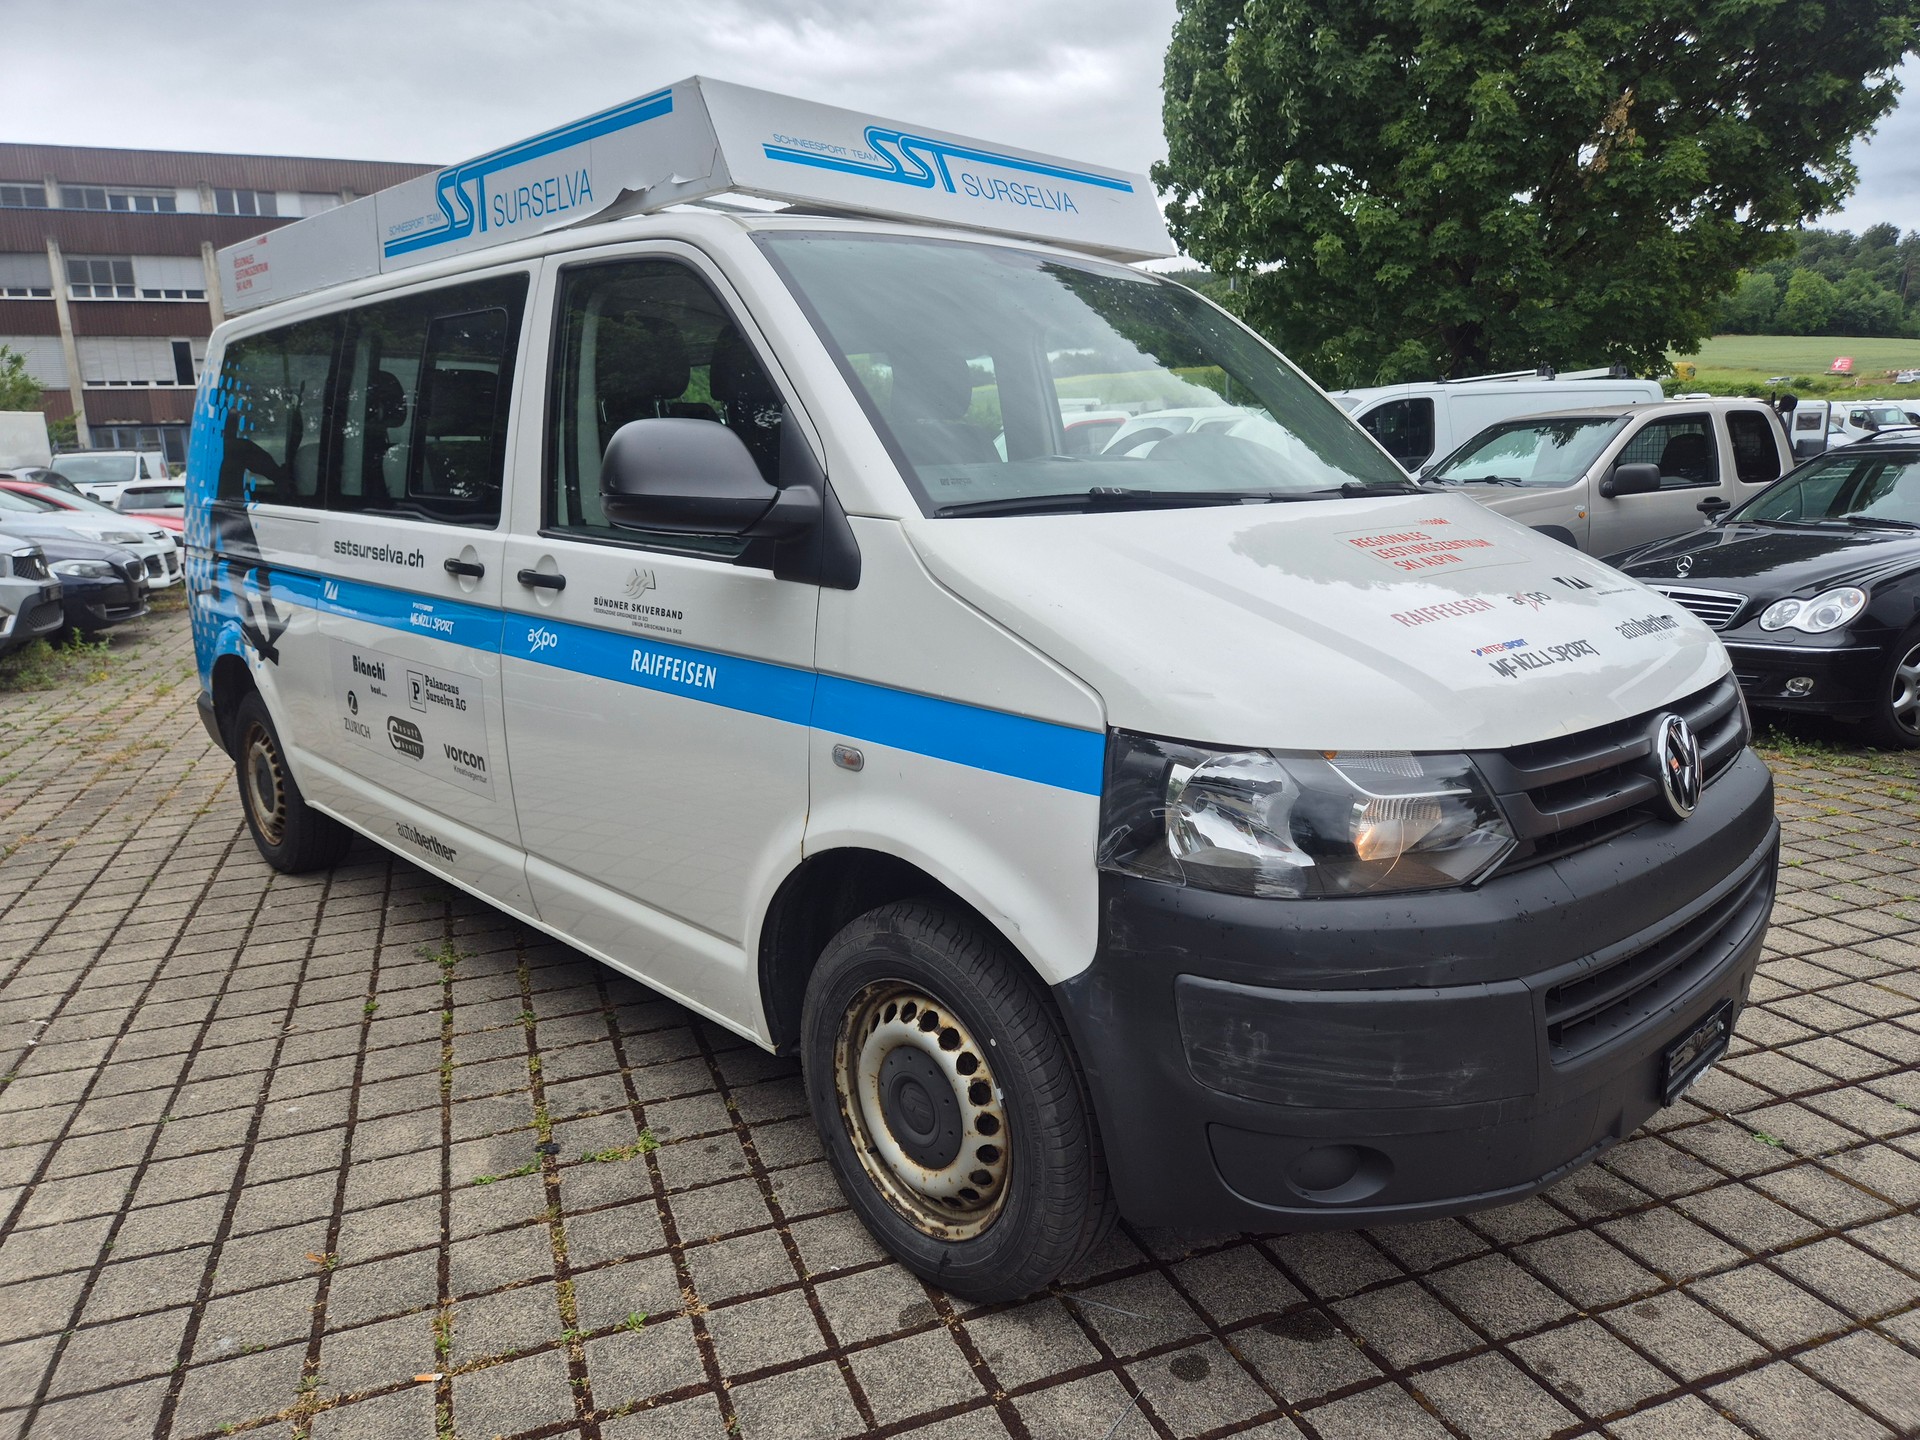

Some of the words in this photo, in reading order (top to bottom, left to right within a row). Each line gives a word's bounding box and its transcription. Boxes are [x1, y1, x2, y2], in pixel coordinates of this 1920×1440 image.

[773, 133, 848, 156] SCHNEESPORT
[851, 148, 879, 163] TEAM
[863, 125, 957, 194] SST
[436, 168, 488, 234] SST
[494, 168, 593, 226] SURSELVA
[961, 173, 1079, 214] SURSELVA
[1348, 531, 1433, 548] REGIONALES
[1371, 539, 1494, 559] LEISTUNGSZENTRUM
[334, 540, 424, 568] sstsurselva.ch
[1393, 560, 1425, 570] SKI
[1419, 553, 1463, 567] ALPIN
[594, 596, 629, 611] BÜNDNER
[631, 603, 683, 620] SKIVERBAND
[1390, 597, 1497, 628] RAIFFEISEN
[432, 618, 455, 635] SPORT
[1481, 638, 1528, 655] INTERSPORT
[1550, 639, 1601, 662] SPORT
[352, 654, 386, 681] Bianchi
[630, 649, 717, 690] RAIFFEISEN
[426, 689, 454, 708] Surselva
[455, 698, 467, 711] AG
[343, 717, 371, 739] ZURICH
[443, 743, 486, 772] vorcon
